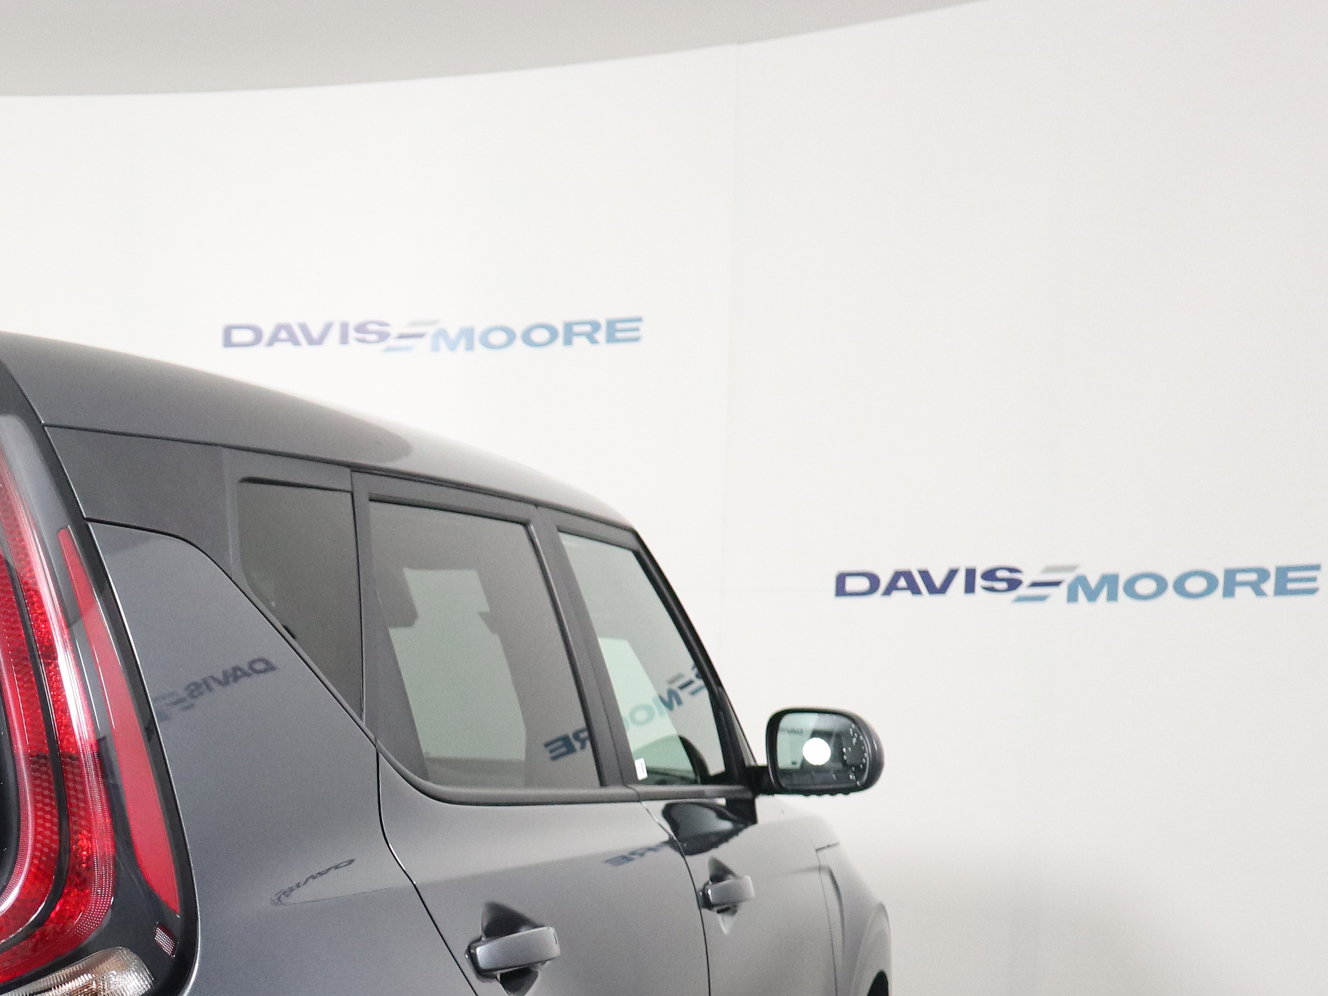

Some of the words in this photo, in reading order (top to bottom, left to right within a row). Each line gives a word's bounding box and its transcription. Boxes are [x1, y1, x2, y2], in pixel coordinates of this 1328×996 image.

[222, 320, 391, 348] DAVIS
[430, 316, 643, 353] MOORE
[834, 565, 1024, 597] DAVIS
[1067, 563, 1322, 604] MOORE
